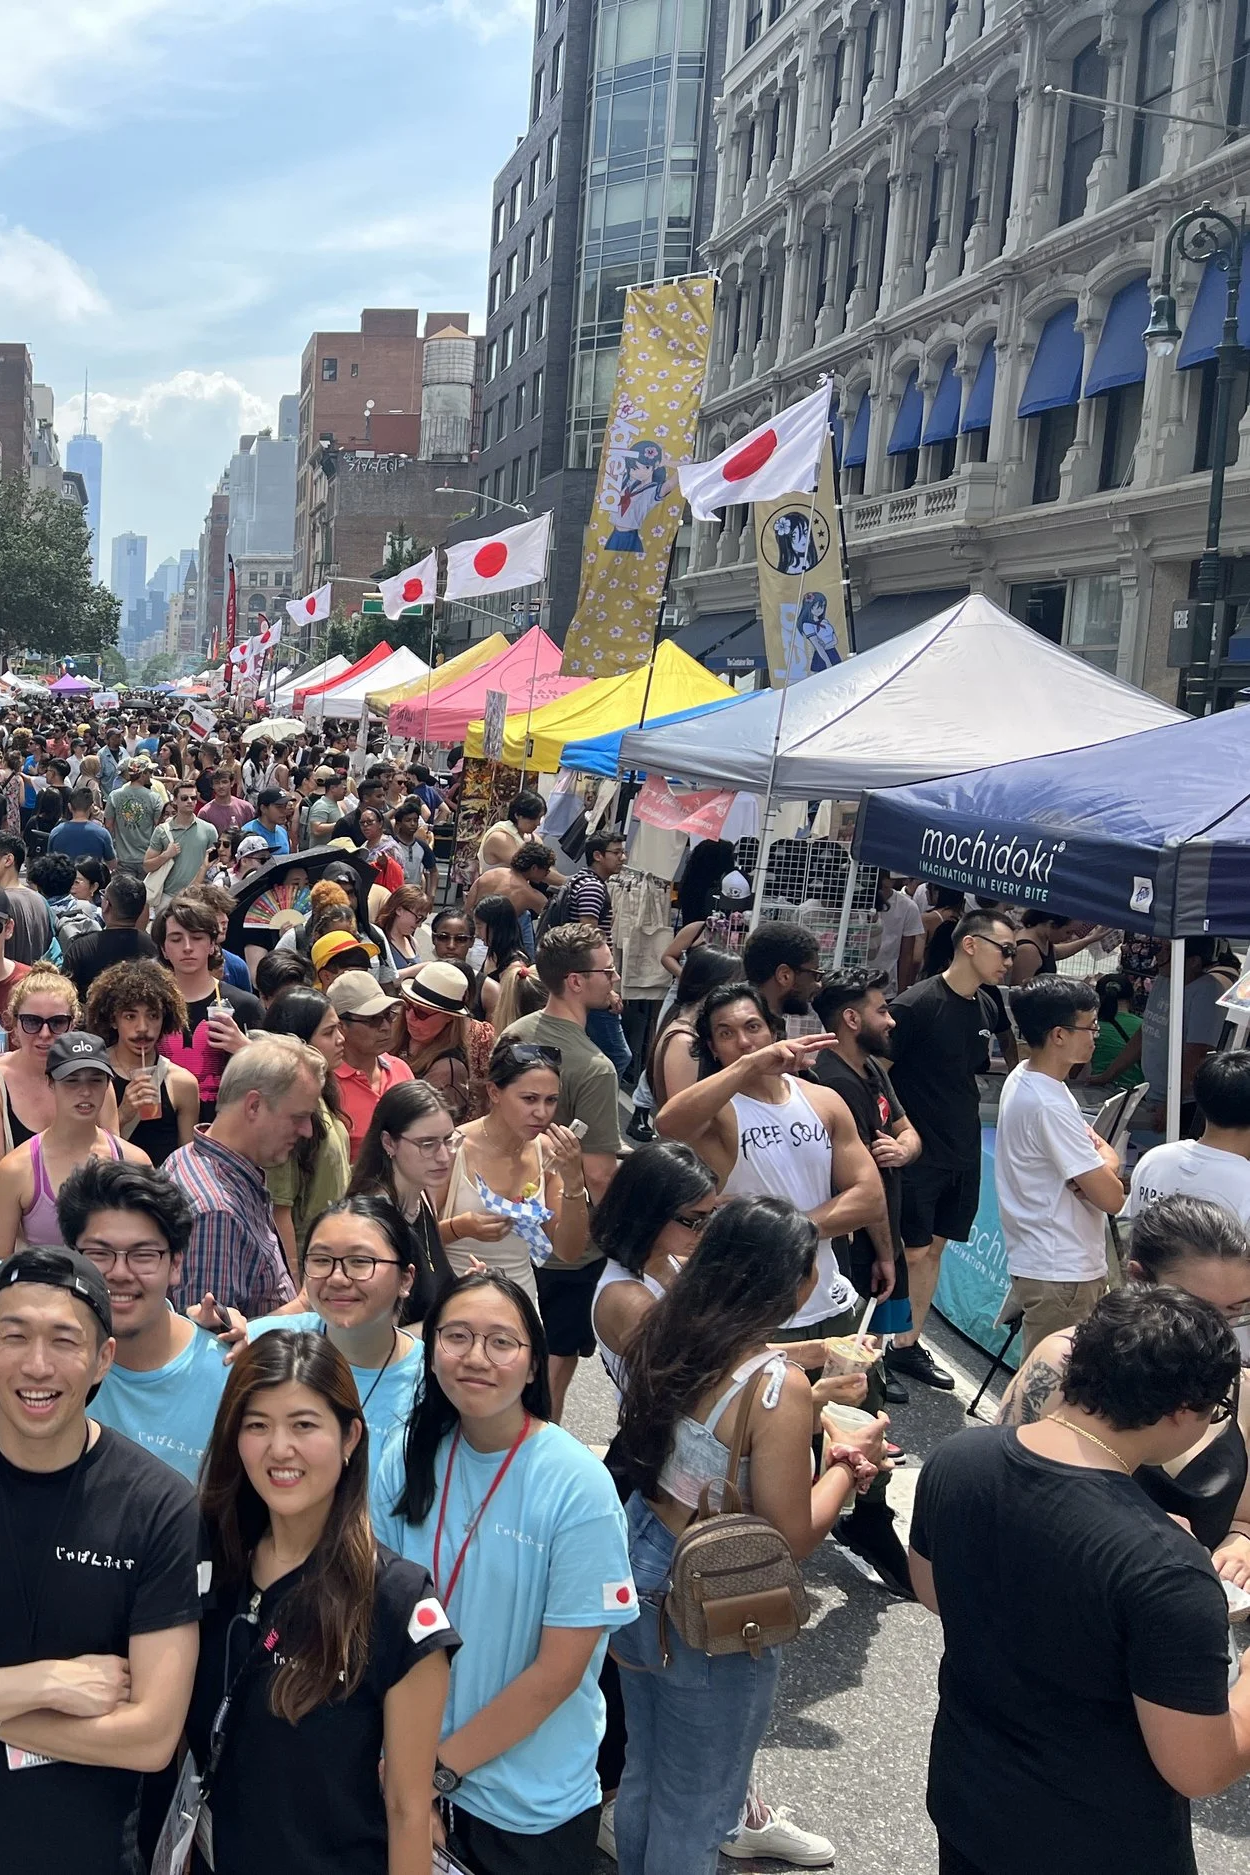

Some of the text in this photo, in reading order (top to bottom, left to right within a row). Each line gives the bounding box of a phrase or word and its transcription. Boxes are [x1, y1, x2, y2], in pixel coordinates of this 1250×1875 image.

[919, 860, 1049, 902] IMAGINATION IN EVERY BITE
[72, 1040, 93, 1053] alo
[741, 1125, 782, 1160] FREE
[966, 1225, 1007, 1270] ochi
[949, 1241, 1012, 1290] AGINATION IN EV
[56, 1546, 135, 1570] じゃぱんふぇす
[263, 1628, 280, 1651] NIKE
